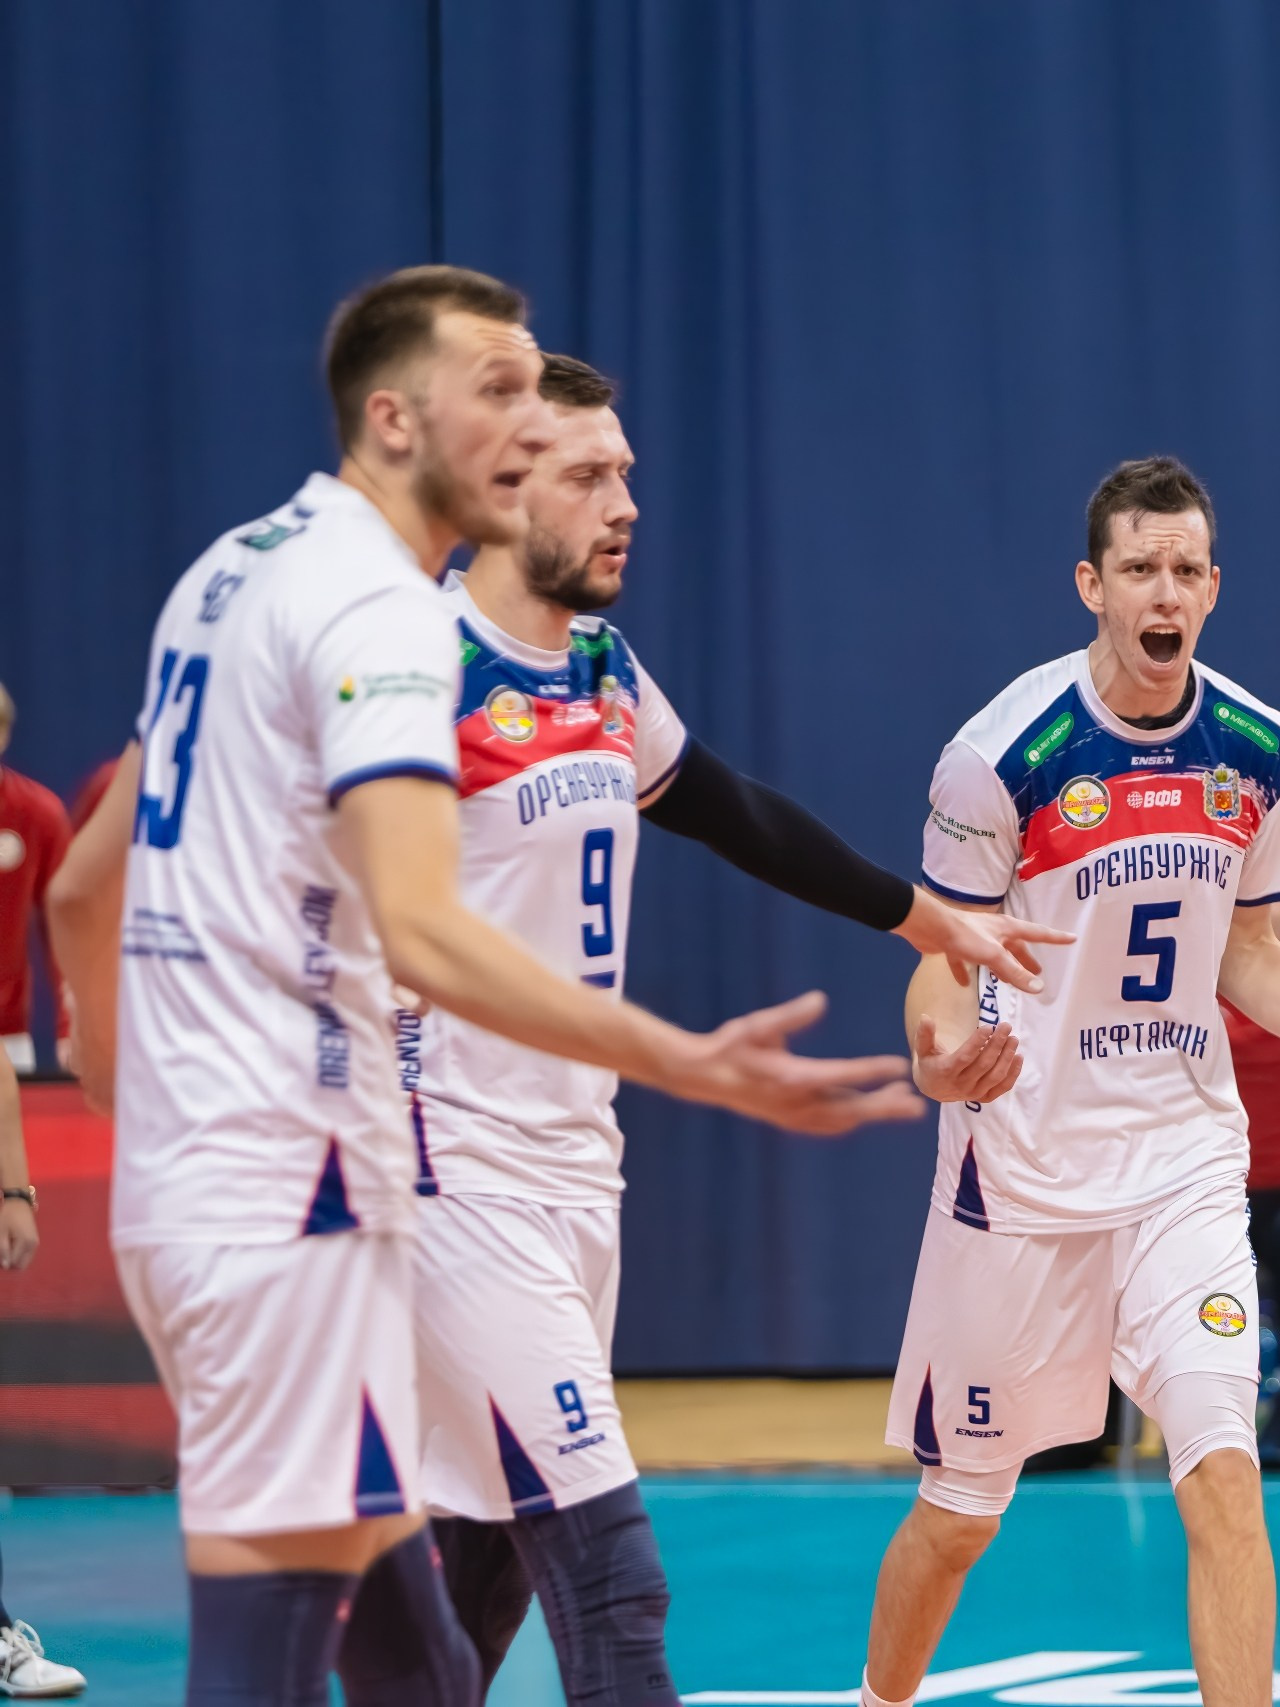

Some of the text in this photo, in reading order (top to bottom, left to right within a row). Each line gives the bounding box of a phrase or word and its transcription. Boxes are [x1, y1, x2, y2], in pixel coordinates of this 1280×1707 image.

[134, 646, 210, 851] 13
[1131, 755, 1175, 766] ENSEN
[1143, 789, 1182, 808] ВФВ
[580, 826, 614, 958] 9
[1076, 843, 1232, 900] ОРЕНБУРЖЬЕ
[1120, 900, 1182, 1002] 5
[1080, 1020, 1209, 1060] НЕФТЯНИК
[553, 1379, 588, 1433] 9
[967, 1385, 990, 1425] 5
[954, 1427, 1004, 1438] ENSEN
